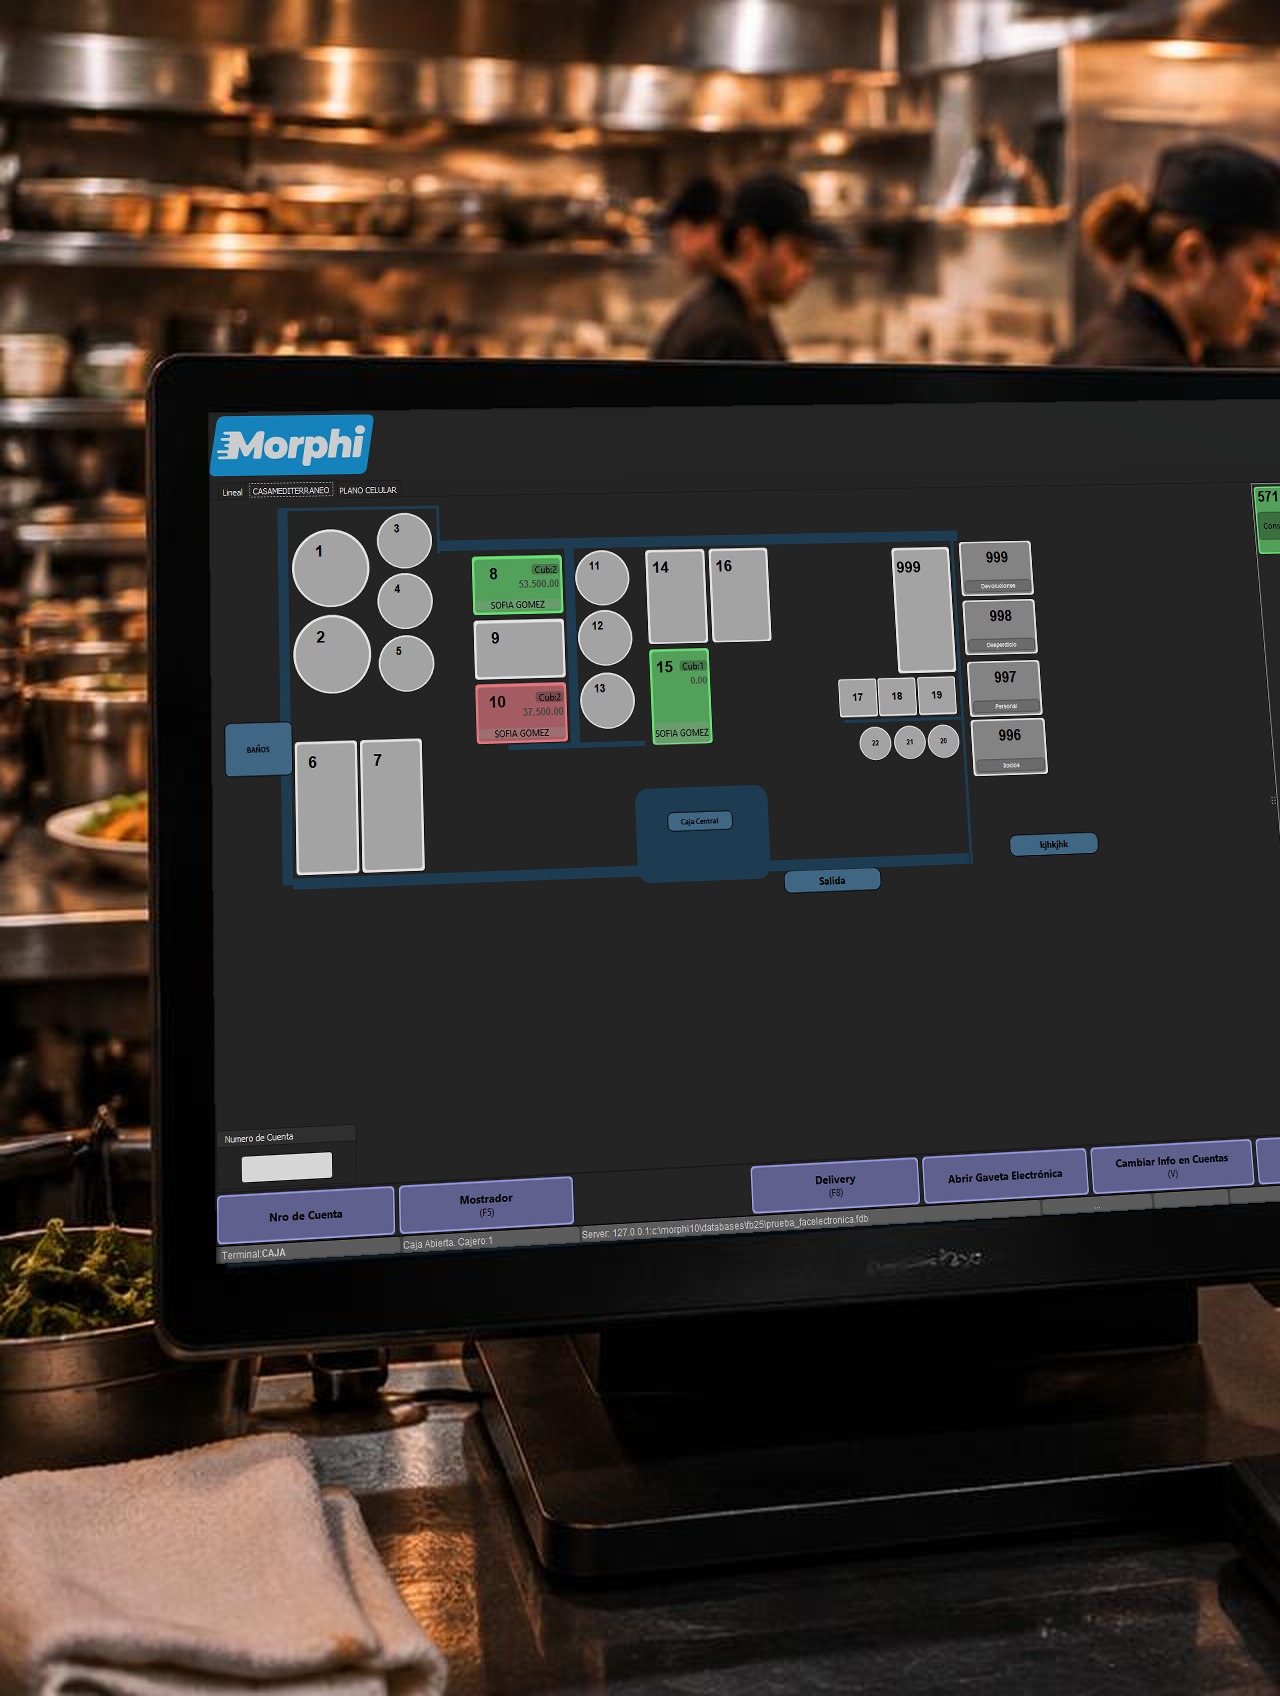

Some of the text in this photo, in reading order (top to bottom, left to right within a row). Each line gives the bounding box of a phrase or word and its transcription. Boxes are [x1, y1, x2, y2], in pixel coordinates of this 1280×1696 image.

[217, 425, 366, 466] Morphi
[222, 488, 243, 496] Lineal
[252, 487, 330, 495] CASAMEDITERRANEO
[365, 486, 397, 494] CELULAR
[1258, 490, 1278, 502] 571
[394, 524, 400, 533] 3
[315, 545, 323, 557] 1
[986, 551, 1008, 563] 999
[534, 566, 557, 574] Cub:2
[589, 561, 600, 570] 11
[652, 561, 669, 573] 14
[716, 560, 732, 572] 16
[896, 561, 920, 573] 999
[490, 568, 498, 580] 8
[518, 579, 559, 588] 53.500.00
[394, 584, 401, 594] 4
[491, 600, 545, 609] SOFIA GOMEZ
[989, 610, 1012, 622] 998
[592, 621, 603, 630] 12
[316, 631, 325, 643] 2
[491, 632, 499, 644] 9
[396, 646, 402, 655] 5
[656, 661, 673, 673] 15
[682, 662, 704, 670] Cub:1
[690, 676, 707, 684] 0.00
[994, 671, 1016, 683] 997
[594, 684, 606, 693] 13
[538, 692, 561, 702] Cub:2
[852, 693, 863, 701] 17
[892, 692, 903, 700] 18
[932, 690, 943, 699] 19
[490, 696, 506, 708] 10
[523, 707, 564, 716] 37.500.00
[494, 729, 550, 738] SOFIA GOMEZ
[655, 728, 709, 738] SOFIA GOMEZ
[998, 729, 1021, 741] 996
[247, 744, 270, 753] BAÑOS
[308, 756, 317, 768] 6
[374, 754, 382, 766] 7
[680, 816, 719, 827] Caja Central
[819, 876, 845, 886] Salida
[225, 1132, 294, 1143] Numero de Cuenta
[1116, 1158, 1155, 1168] Cambiar
[1158, 1156, 1176, 1166] Info
[1192, 1154, 1228, 1164] Cuentas
[815, 1174, 856, 1186] Delivery
[948, 1169, 1062, 1184] Abrir Gaveta Electrónica
[829, 1188, 844, 1198] (F8)
[460, 1194, 513, 1204] Mostrador
[269, 1210, 343, 1222] Nro de Cuenta
[480, 1208, 494, 1218] (F5)
[403, 1236, 493, 1250] Caja Abierta. Cajero:1
[222, 1248, 286, 1260] Terminal:CAJA
